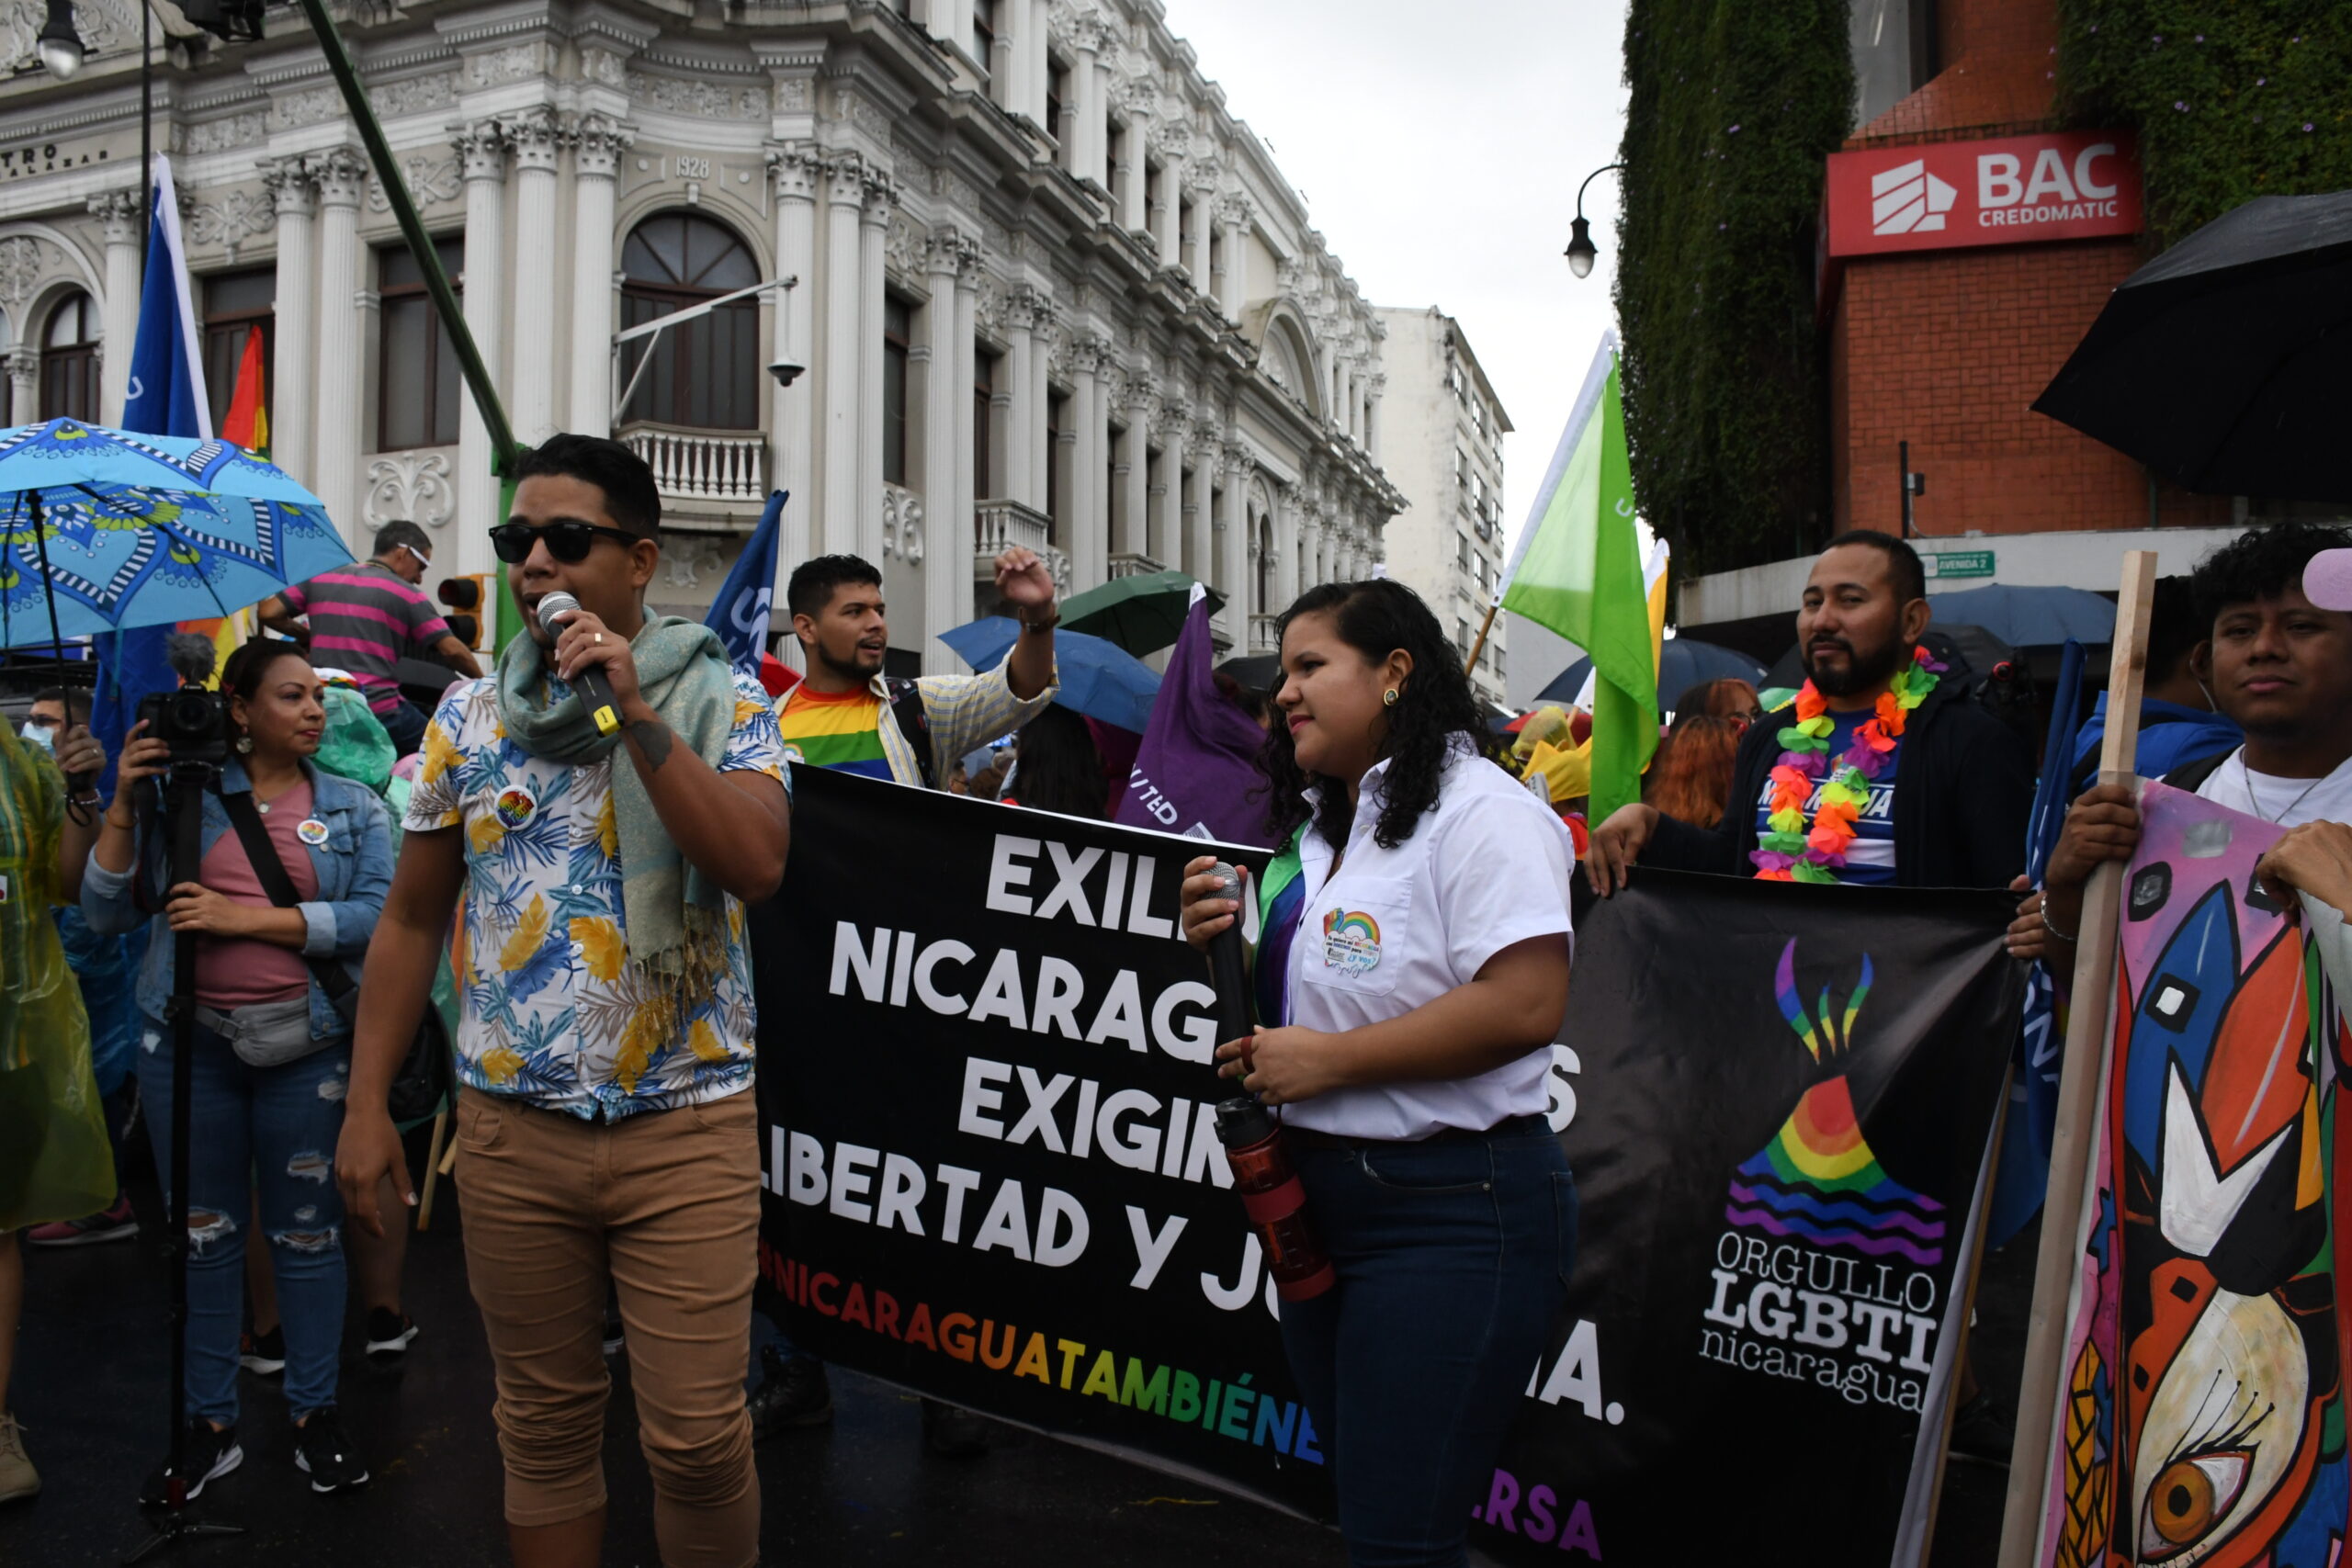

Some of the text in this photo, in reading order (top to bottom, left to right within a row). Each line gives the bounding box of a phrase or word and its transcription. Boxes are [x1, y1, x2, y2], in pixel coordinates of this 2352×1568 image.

[0, 151, 107, 178] ALAZAR
[676, 155, 709, 179] 1928
[1978, 143, 2117, 208] BAC
[1978, 200, 2118, 227] CREDOMATIC
[1939, 558, 1987, 570] AVENIDA 2
[986, 833, 1186, 942] EXIL
[829, 920, 1218, 1065] NICARAG
[759, 1124, 1090, 1267] IBERTAD
[1717, 1231, 1935, 1313] ORGULLO
[1703, 1269, 1937, 1373] LGBTI
[1699, 1329, 1923, 1414] nicaragua
[1472, 1468, 1602, 1562] RSA
